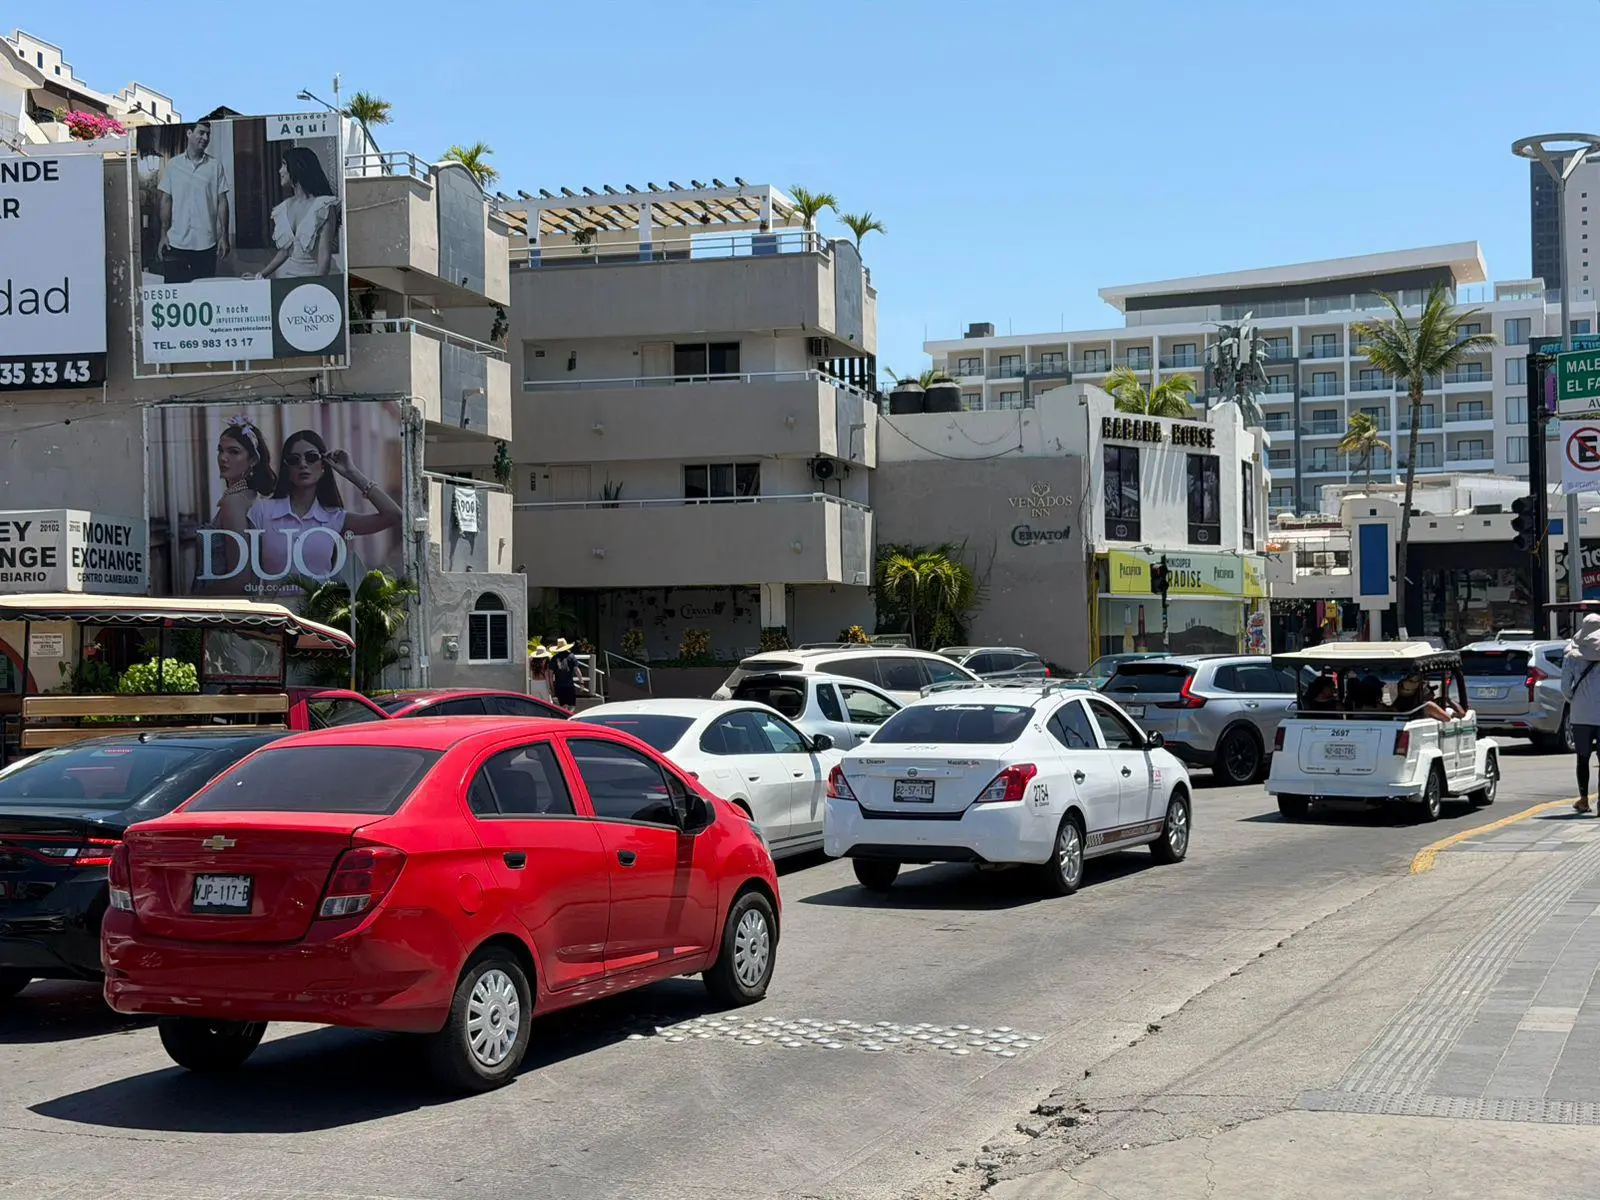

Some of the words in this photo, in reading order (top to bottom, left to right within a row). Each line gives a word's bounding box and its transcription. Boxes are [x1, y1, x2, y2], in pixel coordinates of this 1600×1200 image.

[280, 120, 326, 136] Aquí
[144, 289, 178, 301] DESDE
[226, 304, 249, 314] noche
[151, 301, 213, 331] $900
[287, 314, 335, 325] VENADOS
[153, 341, 176, 350] TEL.
[179, 340, 199, 349] 669
[202, 339, 221, 348] 983
[225, 338, 238, 347] 13
[241, 338, 254, 347] 17
[32, 362, 58, 384] 33
[63, 360, 91, 383] 43
[1567, 379, 1583, 393] EL
[1008, 496, 1072, 508] VENADOS
[1031, 508, 1050, 517] INN
[39, 524, 60, 532] 20102
[82, 522, 132, 546] MONEY
[72, 547, 143, 573] EXCHANGE
[77, 572, 103, 584] CENTRO
[104, 573, 139, 585] CAMBIARIO
[1167, 570, 1202, 588] RADISE
[1331, 729, 1350, 737] 2697
[1033, 783, 1049, 802] 2754
